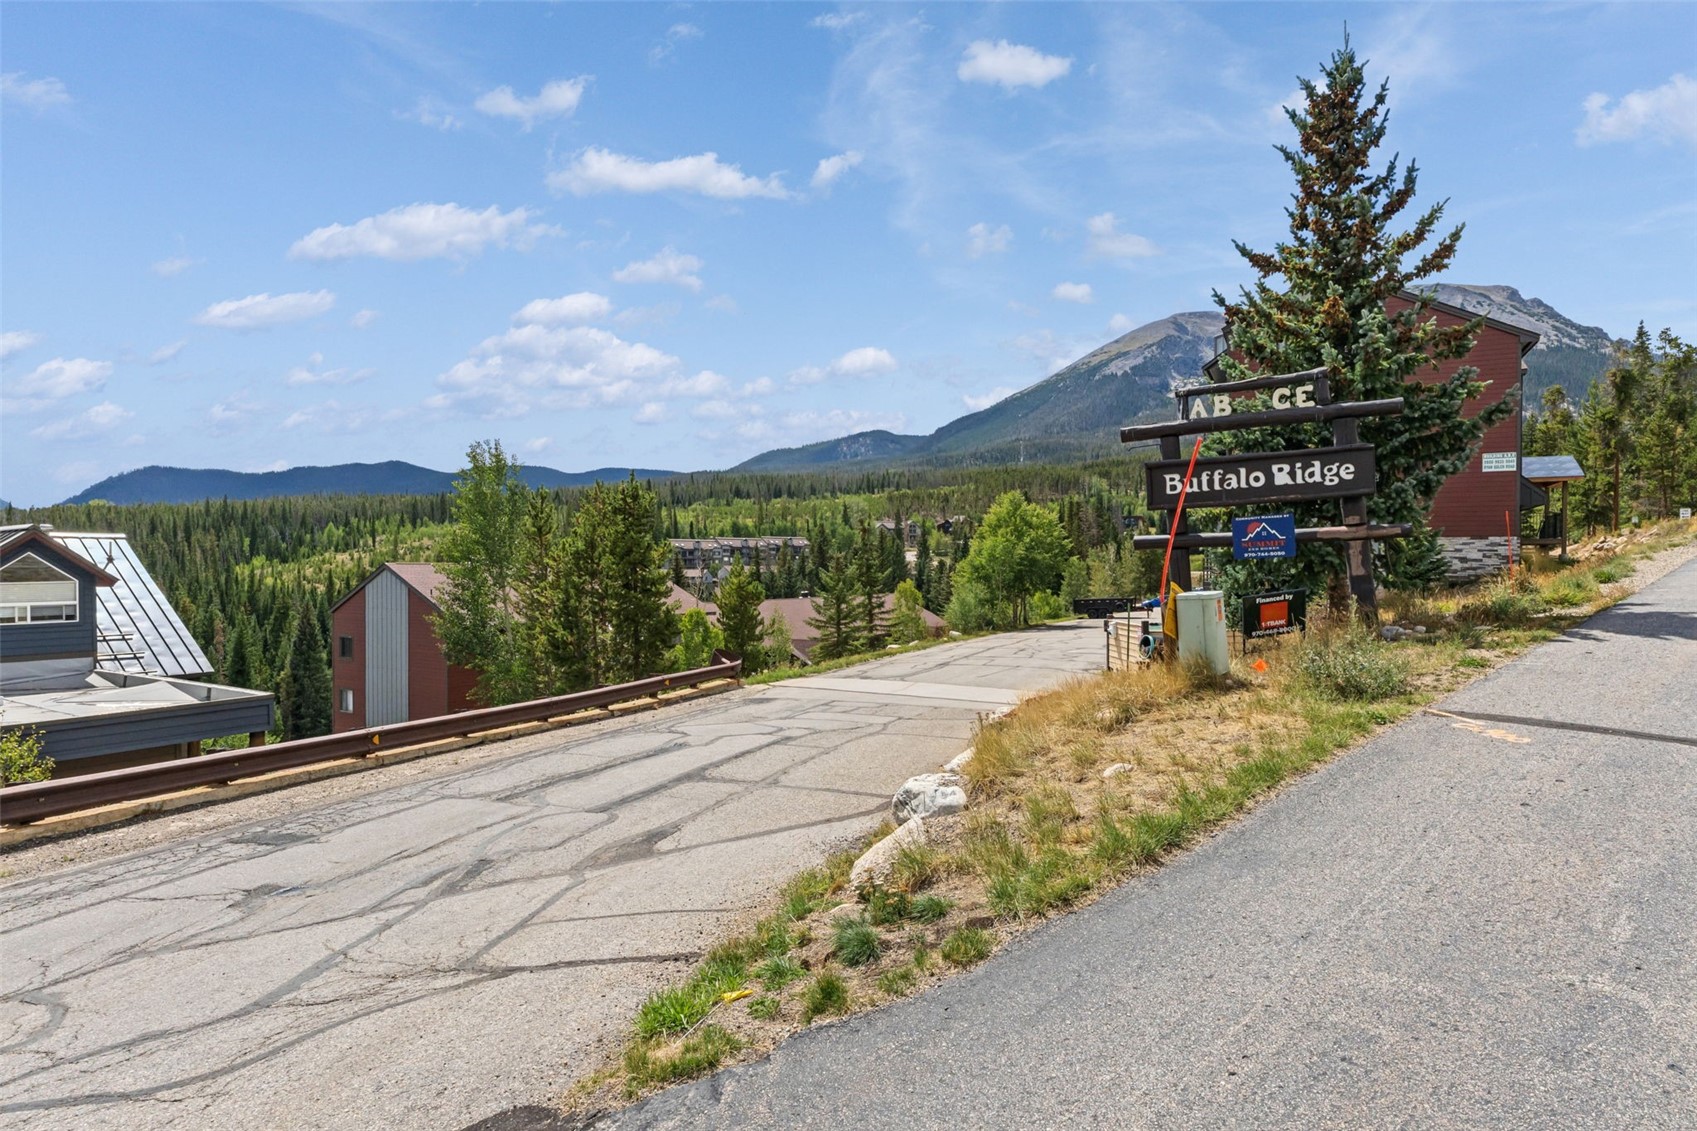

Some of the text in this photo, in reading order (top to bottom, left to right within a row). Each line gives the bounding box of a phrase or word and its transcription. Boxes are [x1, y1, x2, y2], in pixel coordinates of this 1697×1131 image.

[1163, 460, 1355, 495] Buffalo Ridge
[1256, 594, 1284, 603] Financed
